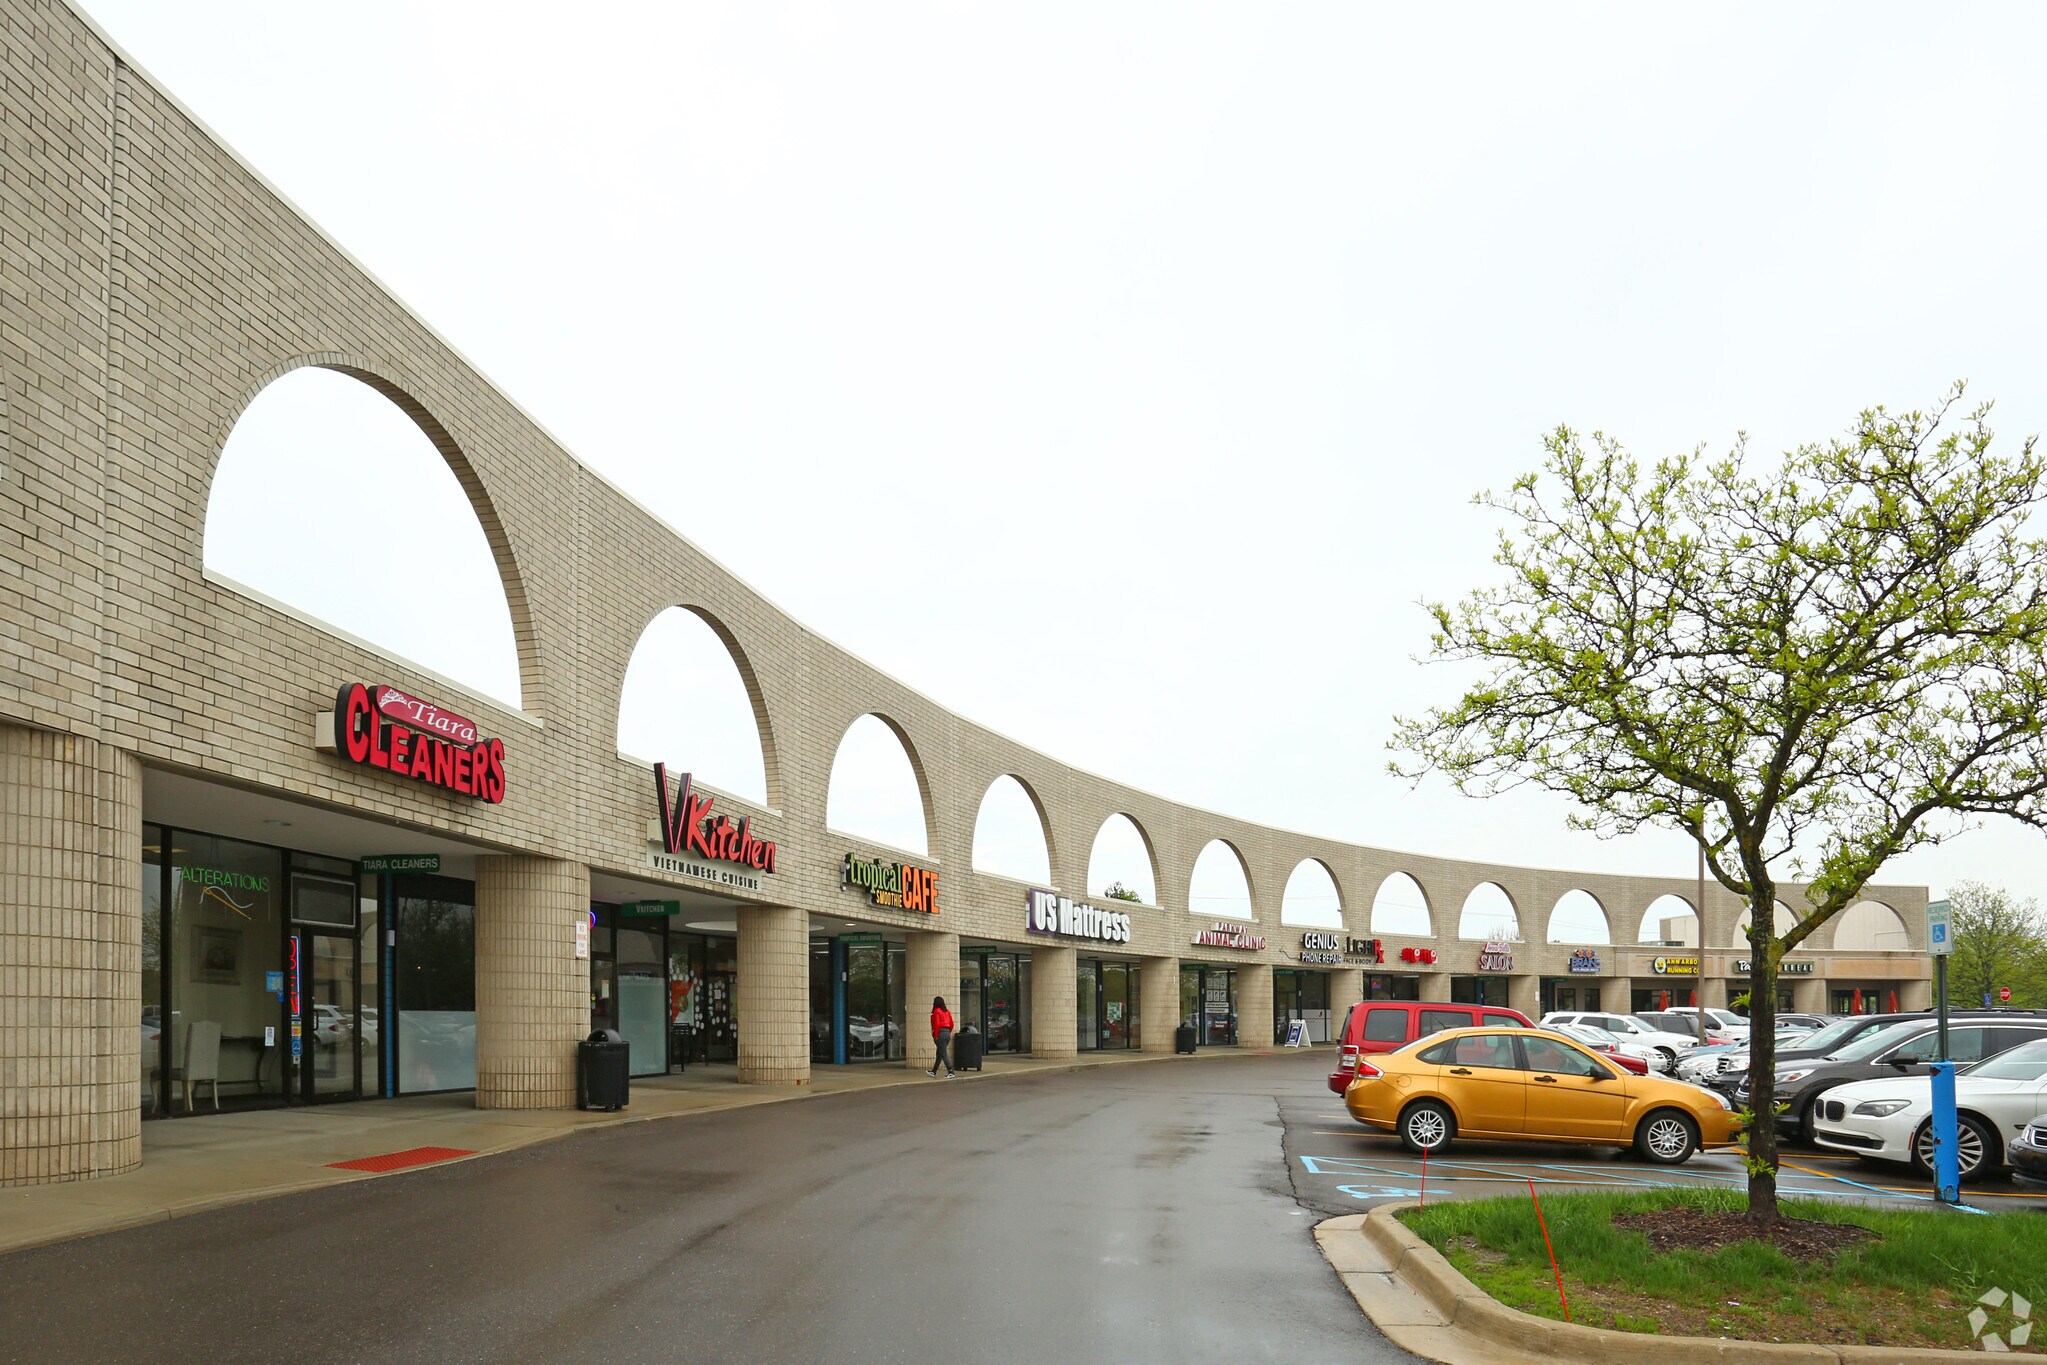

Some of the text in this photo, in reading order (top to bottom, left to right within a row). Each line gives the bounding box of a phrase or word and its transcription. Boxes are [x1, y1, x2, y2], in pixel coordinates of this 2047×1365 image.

[407, 700, 475, 741] Tiara
[345, 682, 506, 804] CLEANERS
[362, 858, 438, 869] TIARA CLEANERS
[653, 855, 758, 890] VIETNAMESE CUISINE
[181, 866, 270, 892] ALTERATIONS
[850, 852, 940, 914] tropical CAFE
[876, 889, 903, 908] SMOOTHIE
[1034, 891, 1131, 943] US Mattress
[1218, 921, 1248, 934] PARKWAY
[1199, 930, 1266, 950] ANIMAL CLINIC
[1304, 932, 1339, 950] GENIUS
[1301, 952, 1342, 964] PHONE REPAIR
[1480, 954, 1515, 970] SALON
